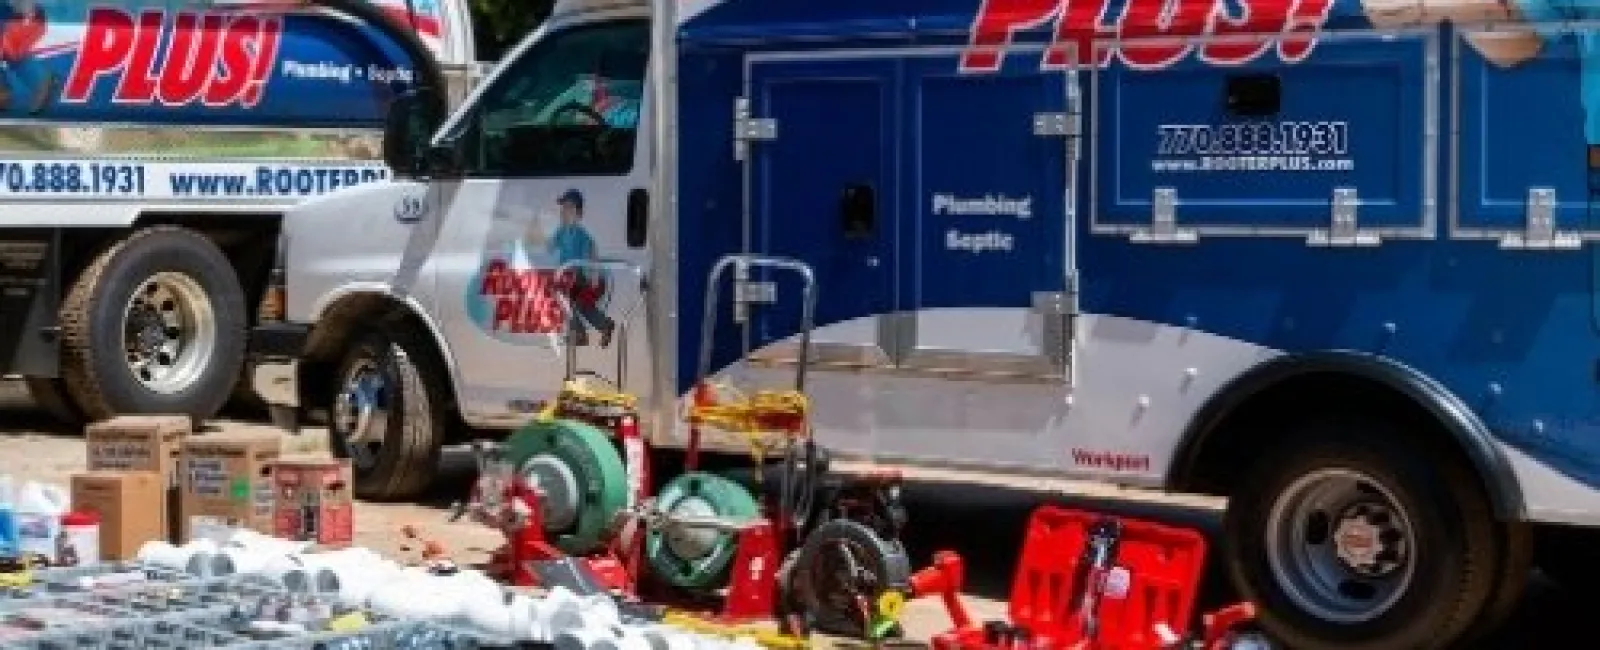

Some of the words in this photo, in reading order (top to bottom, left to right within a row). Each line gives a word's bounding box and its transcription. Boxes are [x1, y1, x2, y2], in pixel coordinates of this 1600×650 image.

[61, 7, 283, 108] PLUS!
[1157, 121, 1348, 155] 770.888.1931
[932, 194, 1032, 219] Plumbing
[945, 230, 1014, 252] Septic
